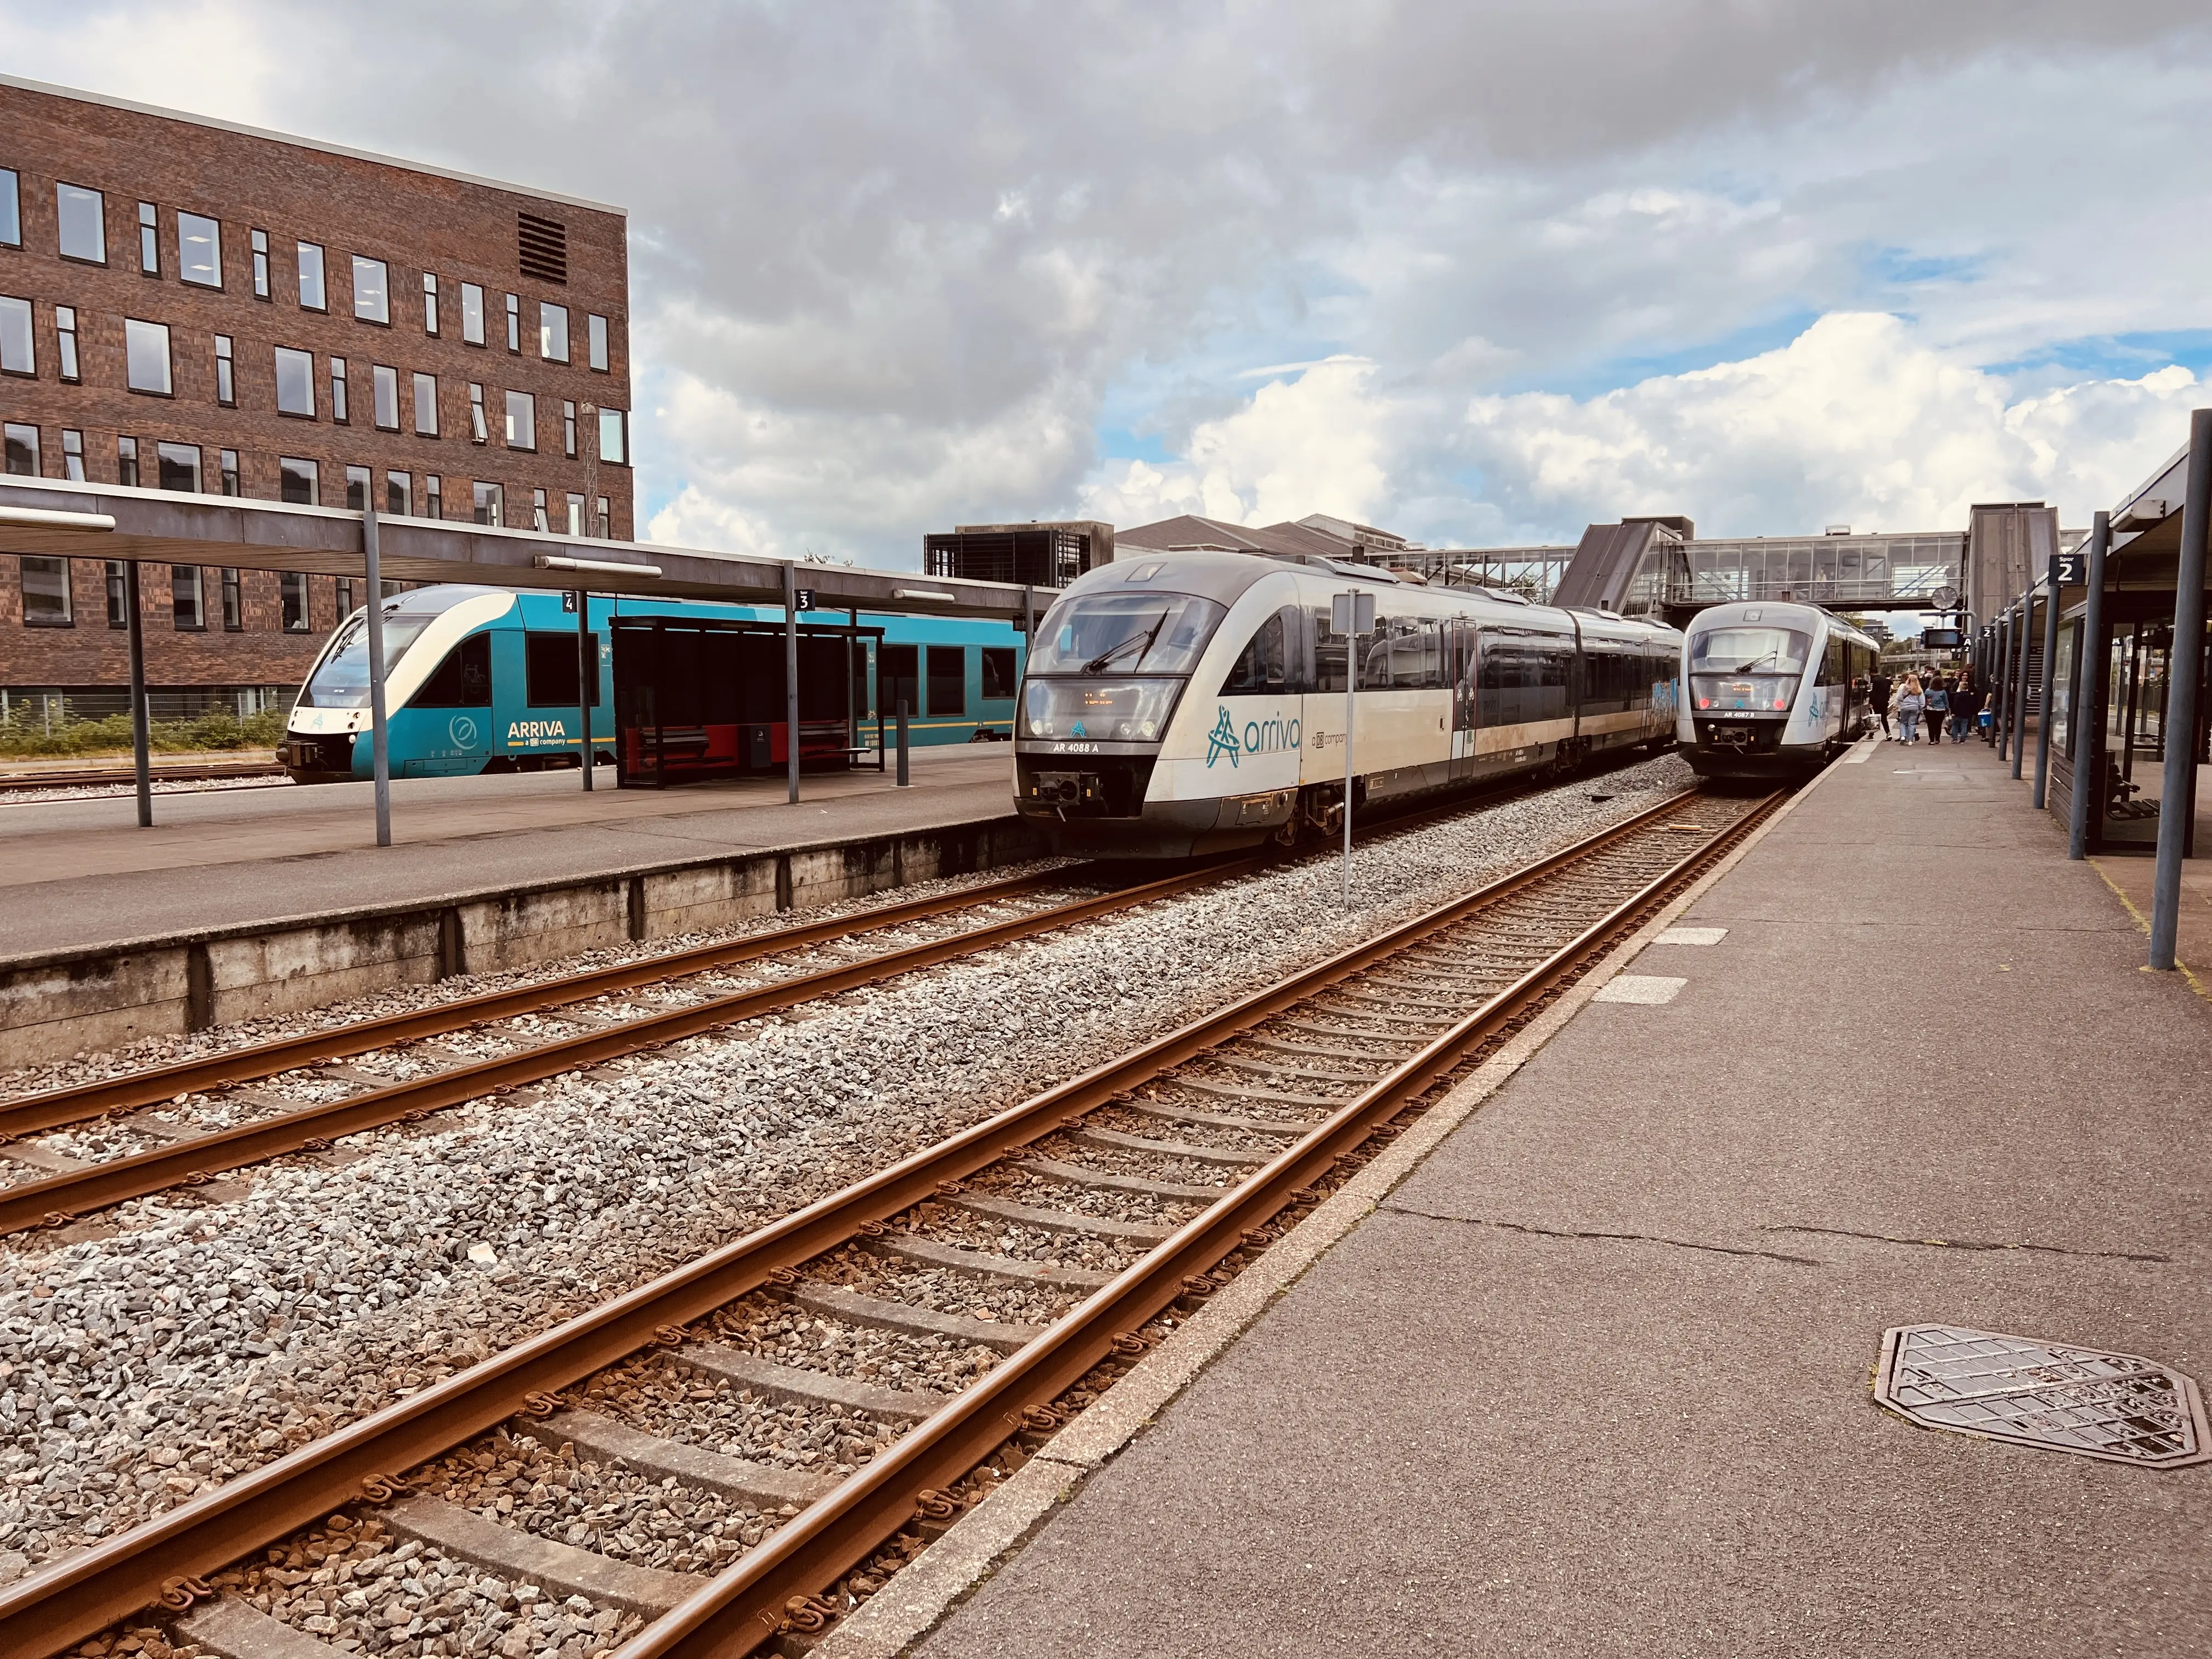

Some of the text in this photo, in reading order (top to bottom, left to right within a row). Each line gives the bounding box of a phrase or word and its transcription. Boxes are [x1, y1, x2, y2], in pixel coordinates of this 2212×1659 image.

[2058, 563, 2072, 581] 2
[566, 598, 572, 610] 4
[800, 596, 808, 608] 3
[507, 721, 566, 738] ARRIVA
[1244, 711, 1300, 753] arriva
[1312, 737, 1316, 746] a
[1317, 734, 1323, 747] DB
[1053, 743, 1099, 753] AR 4088 A
